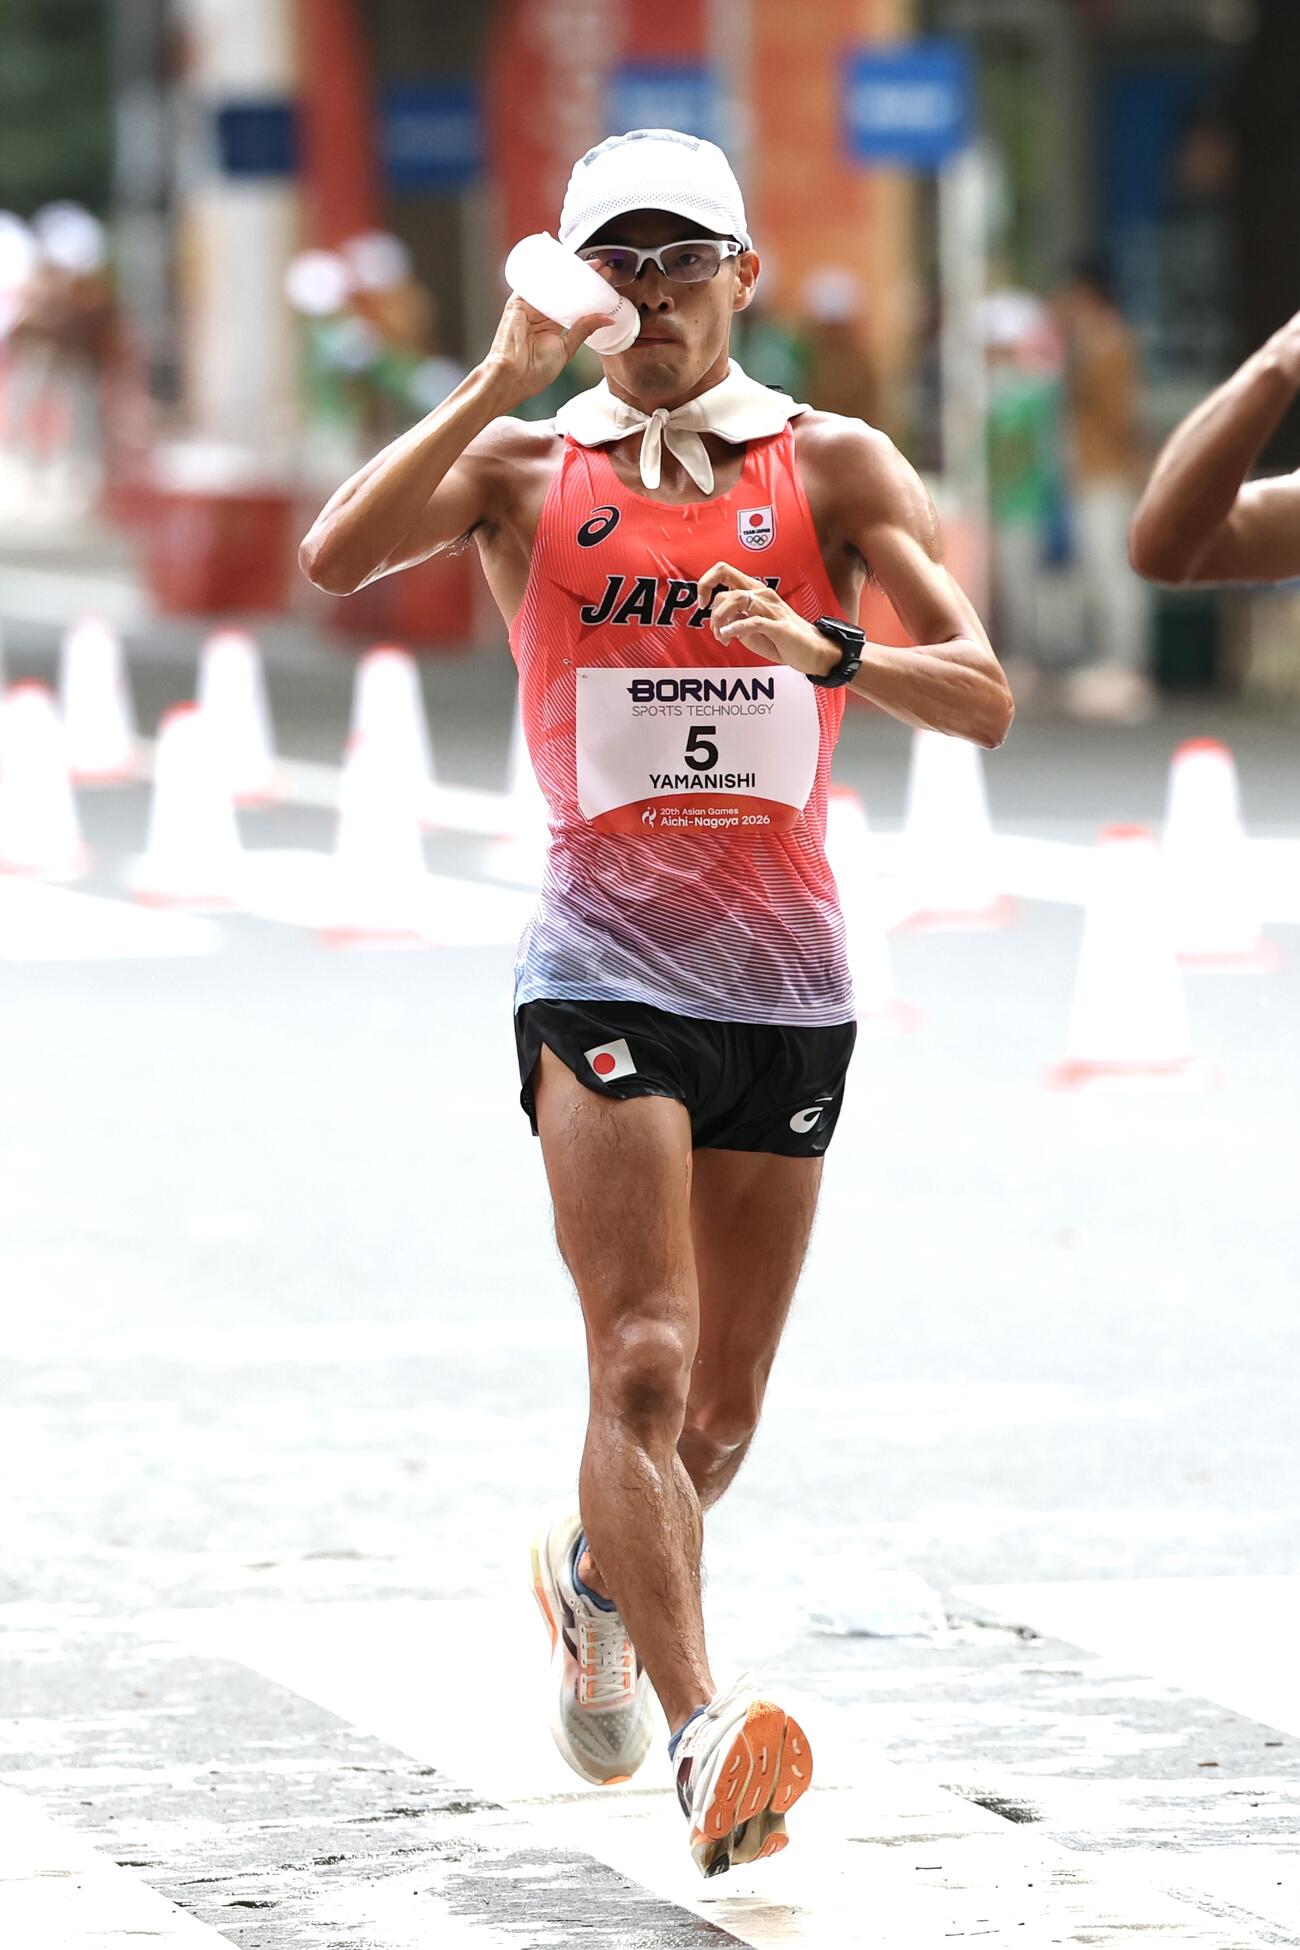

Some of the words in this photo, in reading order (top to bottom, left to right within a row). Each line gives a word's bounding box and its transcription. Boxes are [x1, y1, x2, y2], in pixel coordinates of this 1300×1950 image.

[580, 575, 780, 627] JAP
[626, 677, 774, 702] BORNAN
[632, 705, 682, 717] SPORTS
[686, 704, 774, 716] TECHNOLOGY
[684, 725, 719, 771] 5
[649, 773, 756, 789] YAMANISHI
[660, 807, 680, 816] 20th
[682, 807, 706, 816] Asian
[707, 807, 739, 816] Games
[660, 815, 739, 828] Aichi-Nagoya
[741, 815, 771, 825] 2026
